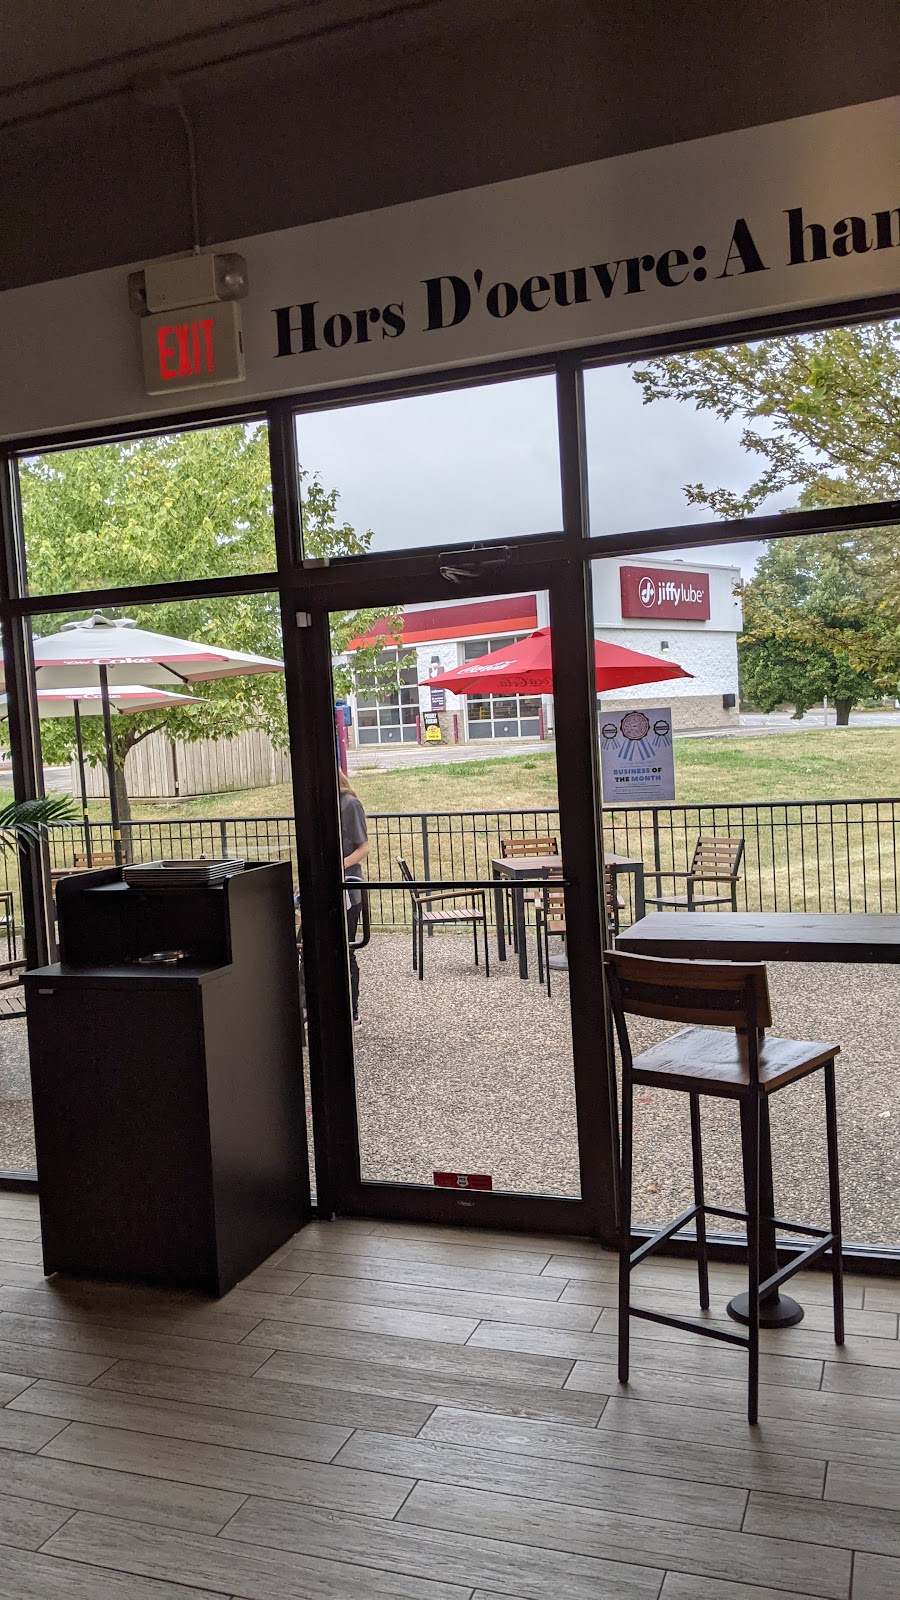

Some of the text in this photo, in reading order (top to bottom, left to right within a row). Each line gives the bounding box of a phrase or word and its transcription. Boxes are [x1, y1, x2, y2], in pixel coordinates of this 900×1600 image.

[271, 301, 406, 358] Hors
[420, 245, 707, 332] D'oeuvre:
[714, 218, 771, 279] A
[157, 319, 215, 380] EXIT
[92, 657, 153, 665] Coke
[613, 767, 650, 775] BUSINESS
